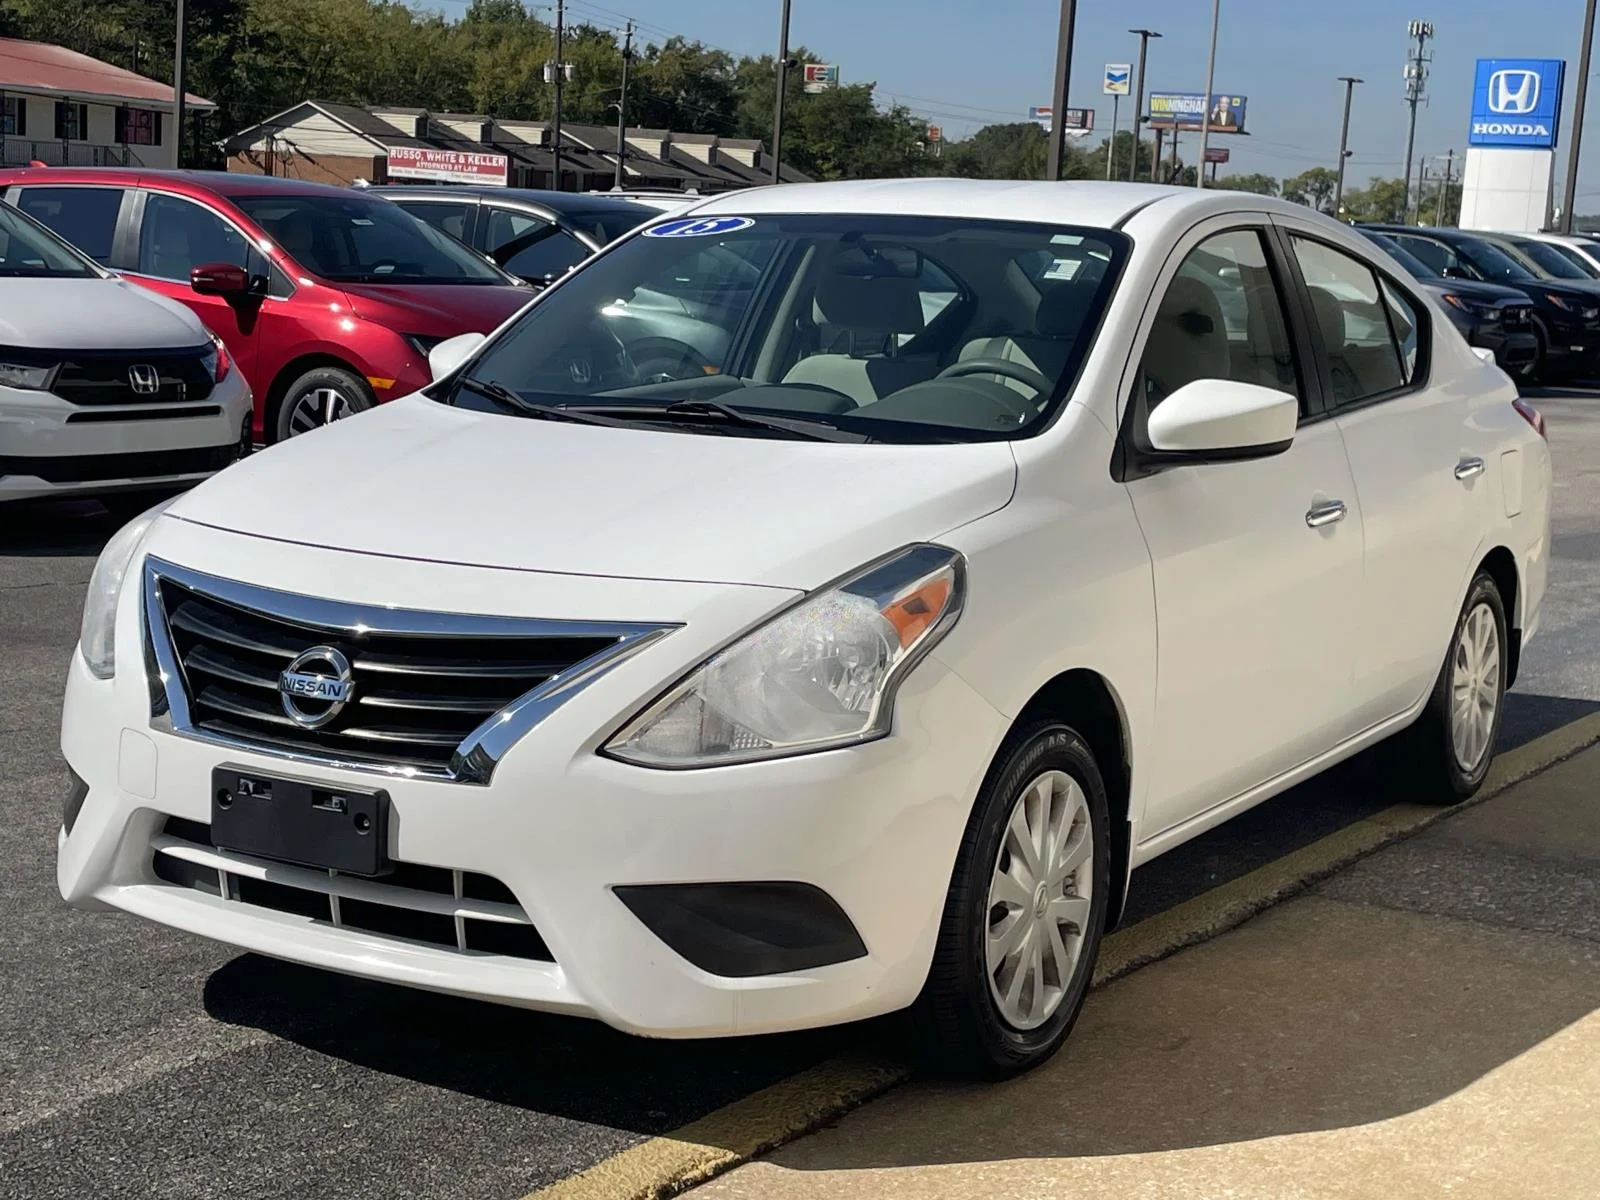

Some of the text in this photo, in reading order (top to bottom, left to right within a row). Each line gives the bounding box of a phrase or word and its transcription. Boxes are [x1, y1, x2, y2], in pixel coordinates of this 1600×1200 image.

[1473, 123, 1549, 136] HONDA
[390, 149, 505, 167] RUSSO, WHITE & KELLER
[416, 161, 478, 173] ATTORNEYS AT LAW
[282, 677, 342, 696] NISSAN
